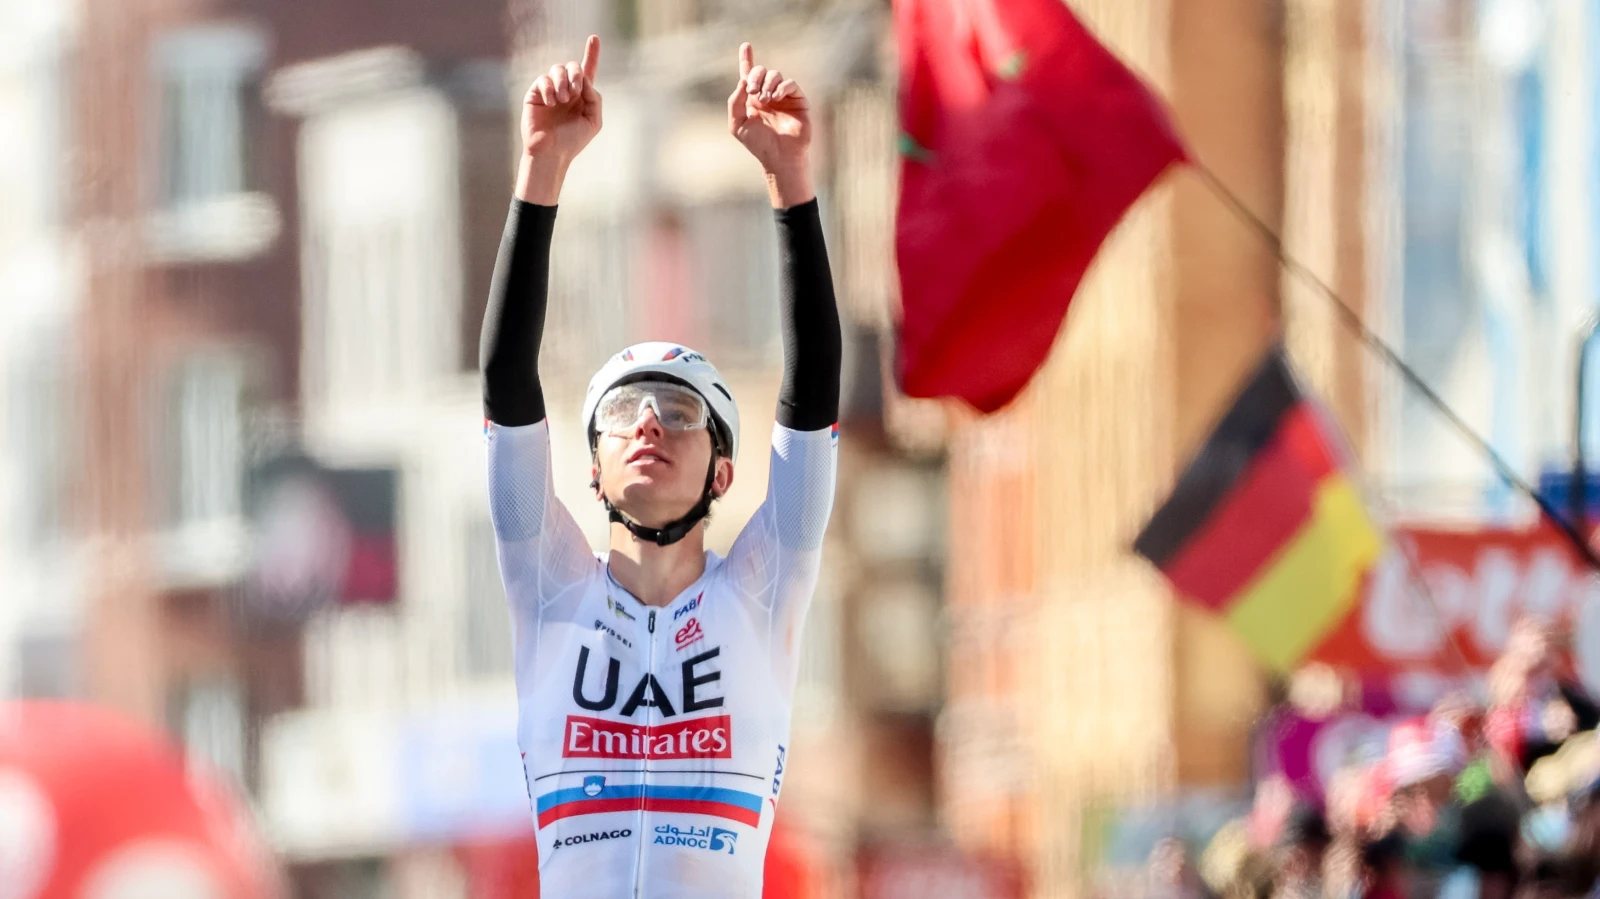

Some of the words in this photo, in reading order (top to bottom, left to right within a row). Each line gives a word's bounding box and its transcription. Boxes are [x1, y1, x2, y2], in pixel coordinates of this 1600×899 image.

[674, 598, 698, 621] FAB
[573, 645, 725, 718] UAE
[569, 721, 728, 756] Emirates
[772, 744, 785, 796] FAB
[564, 829, 632, 846] COLNAGO
[653, 836, 708, 849] ADNOC
